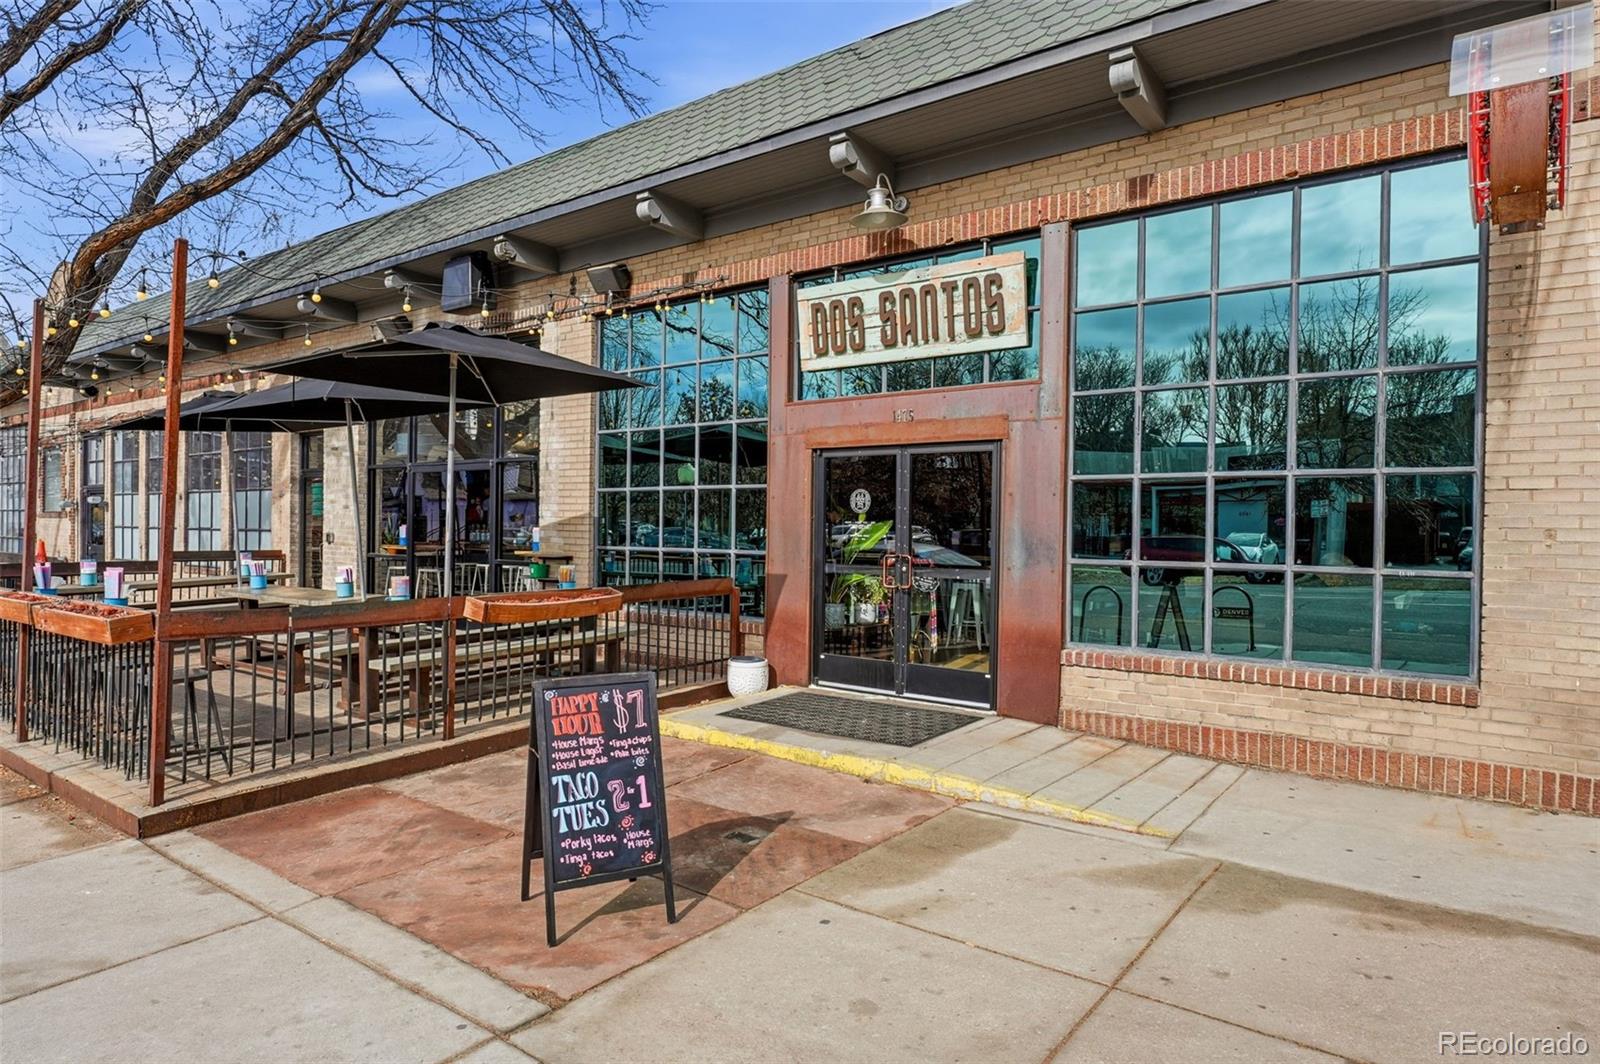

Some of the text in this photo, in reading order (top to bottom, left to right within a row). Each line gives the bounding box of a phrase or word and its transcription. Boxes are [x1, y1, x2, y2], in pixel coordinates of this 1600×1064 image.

[810, 272, 1007, 356] DOS SANTOS
[551, 692, 599, 716] HAPPY
[612, 689, 648, 734] $7
[551, 711, 605, 736] HOUR
[554, 739, 578, 749] House
[555, 750, 579, 760] House
[555, 759, 576, 770] Basil
[551, 771, 599, 804] TACO
[607, 779, 630, 813] 2
[635, 774, 652, 809] 1
[552, 799, 610, 834] TUES
[565, 833, 617, 851] Porky tacos
[626, 829, 650, 840] House
[564, 850, 615, 867] Tinga tacos
